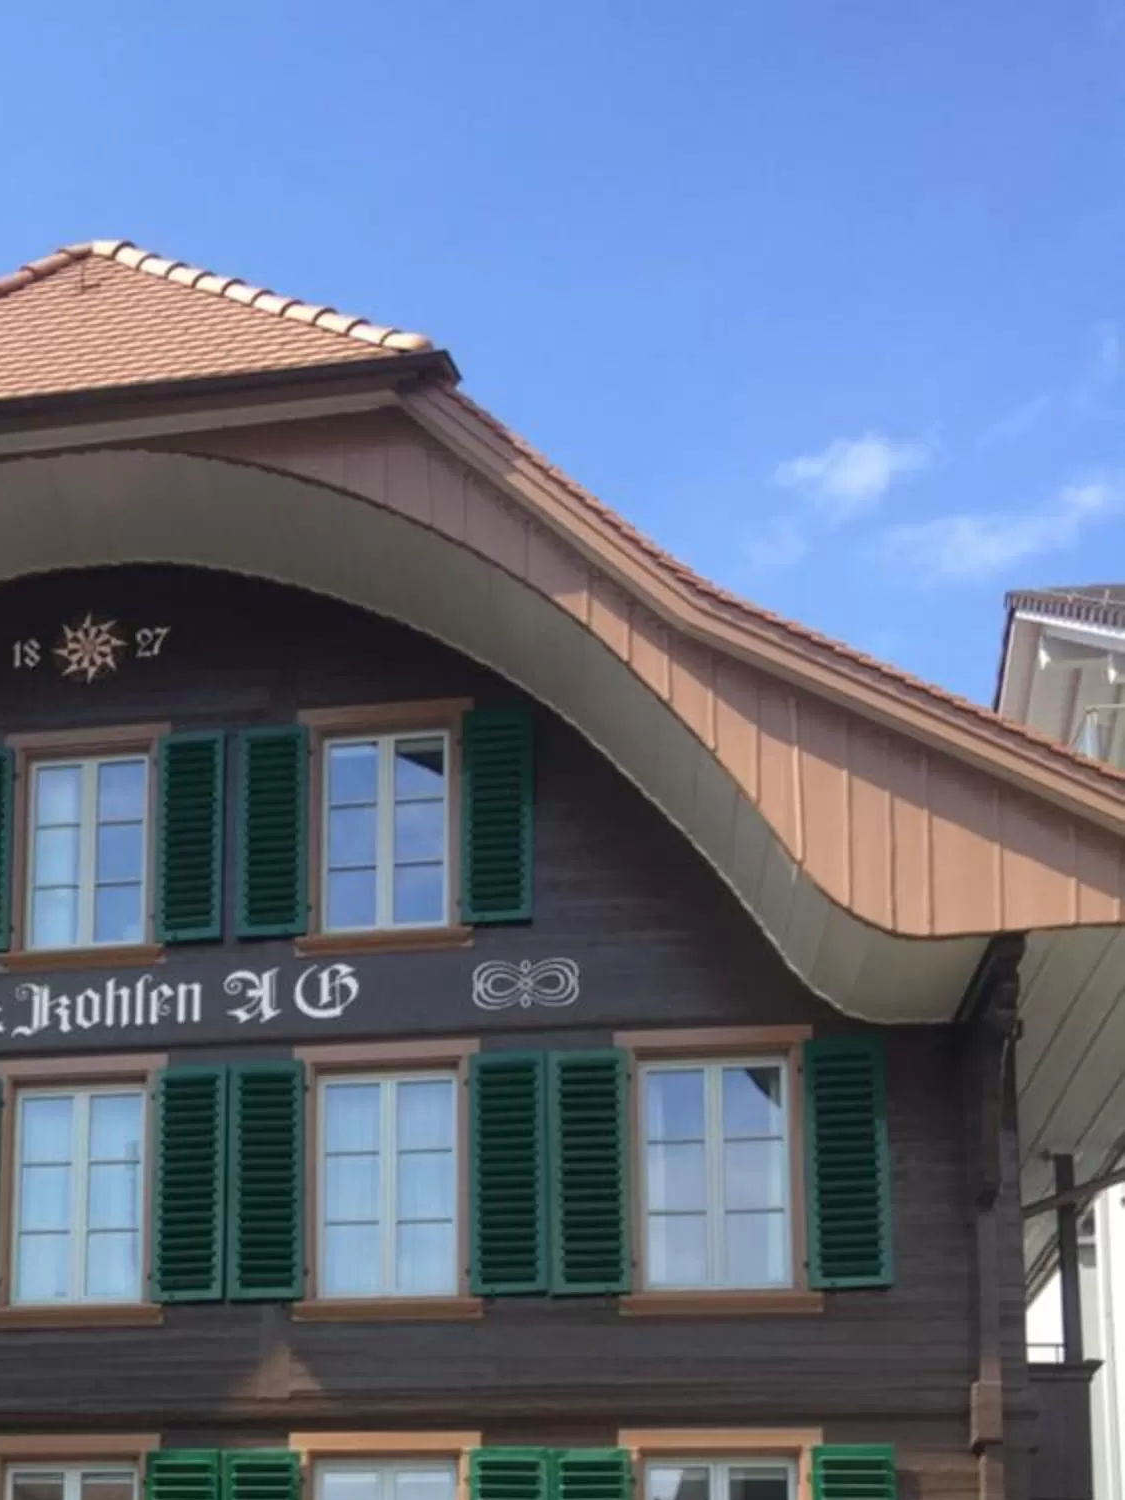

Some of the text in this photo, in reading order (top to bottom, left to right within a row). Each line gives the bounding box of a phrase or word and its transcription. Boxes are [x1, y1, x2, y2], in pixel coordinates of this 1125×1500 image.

[13, 627, 171, 668] 18 27
[11, 974, 202, 1038] Kohlen
